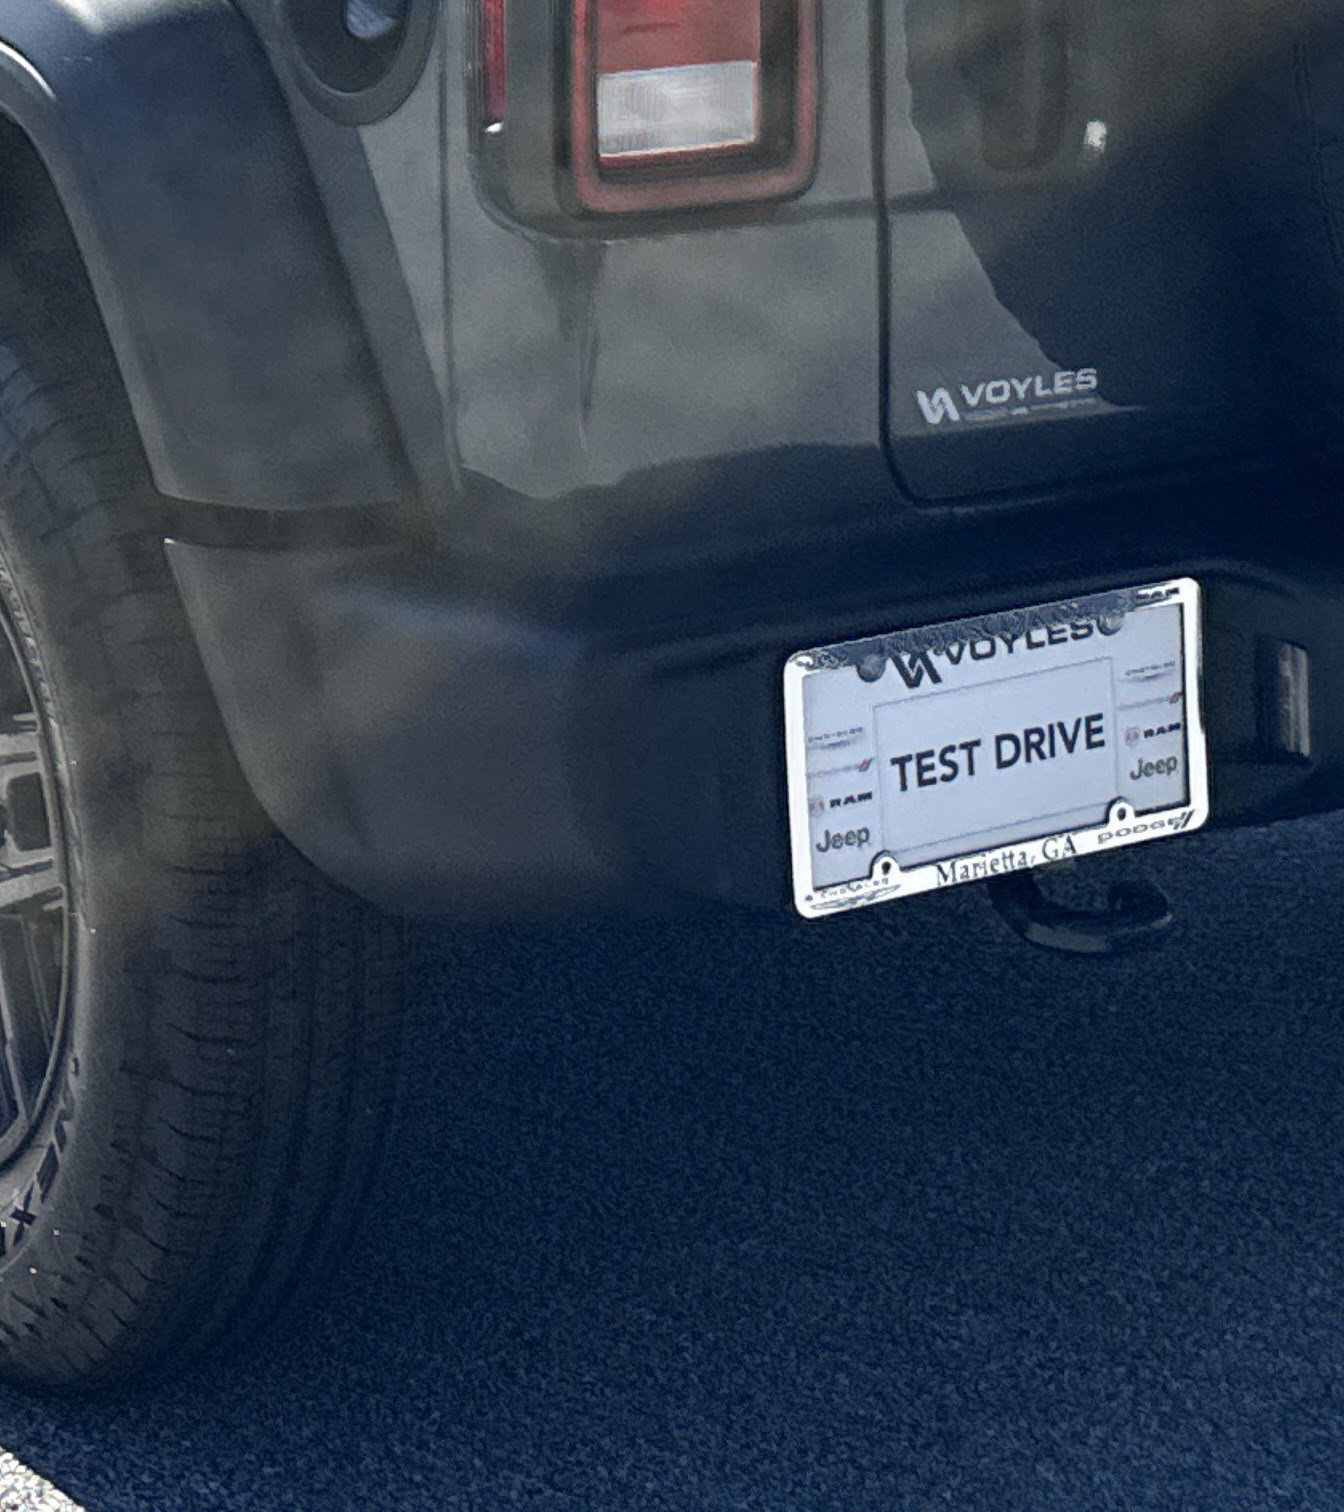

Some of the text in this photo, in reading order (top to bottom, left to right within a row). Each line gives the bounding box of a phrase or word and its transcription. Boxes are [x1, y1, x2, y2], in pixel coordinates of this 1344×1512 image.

[961, 367, 1098, 407] VOYLES
[890, 712, 1106, 792] TEST DRIVE
[1129, 754, 1179, 781] Jeep
[815, 826, 871, 853] Jeep
[1041, 833, 1078, 862] GA
